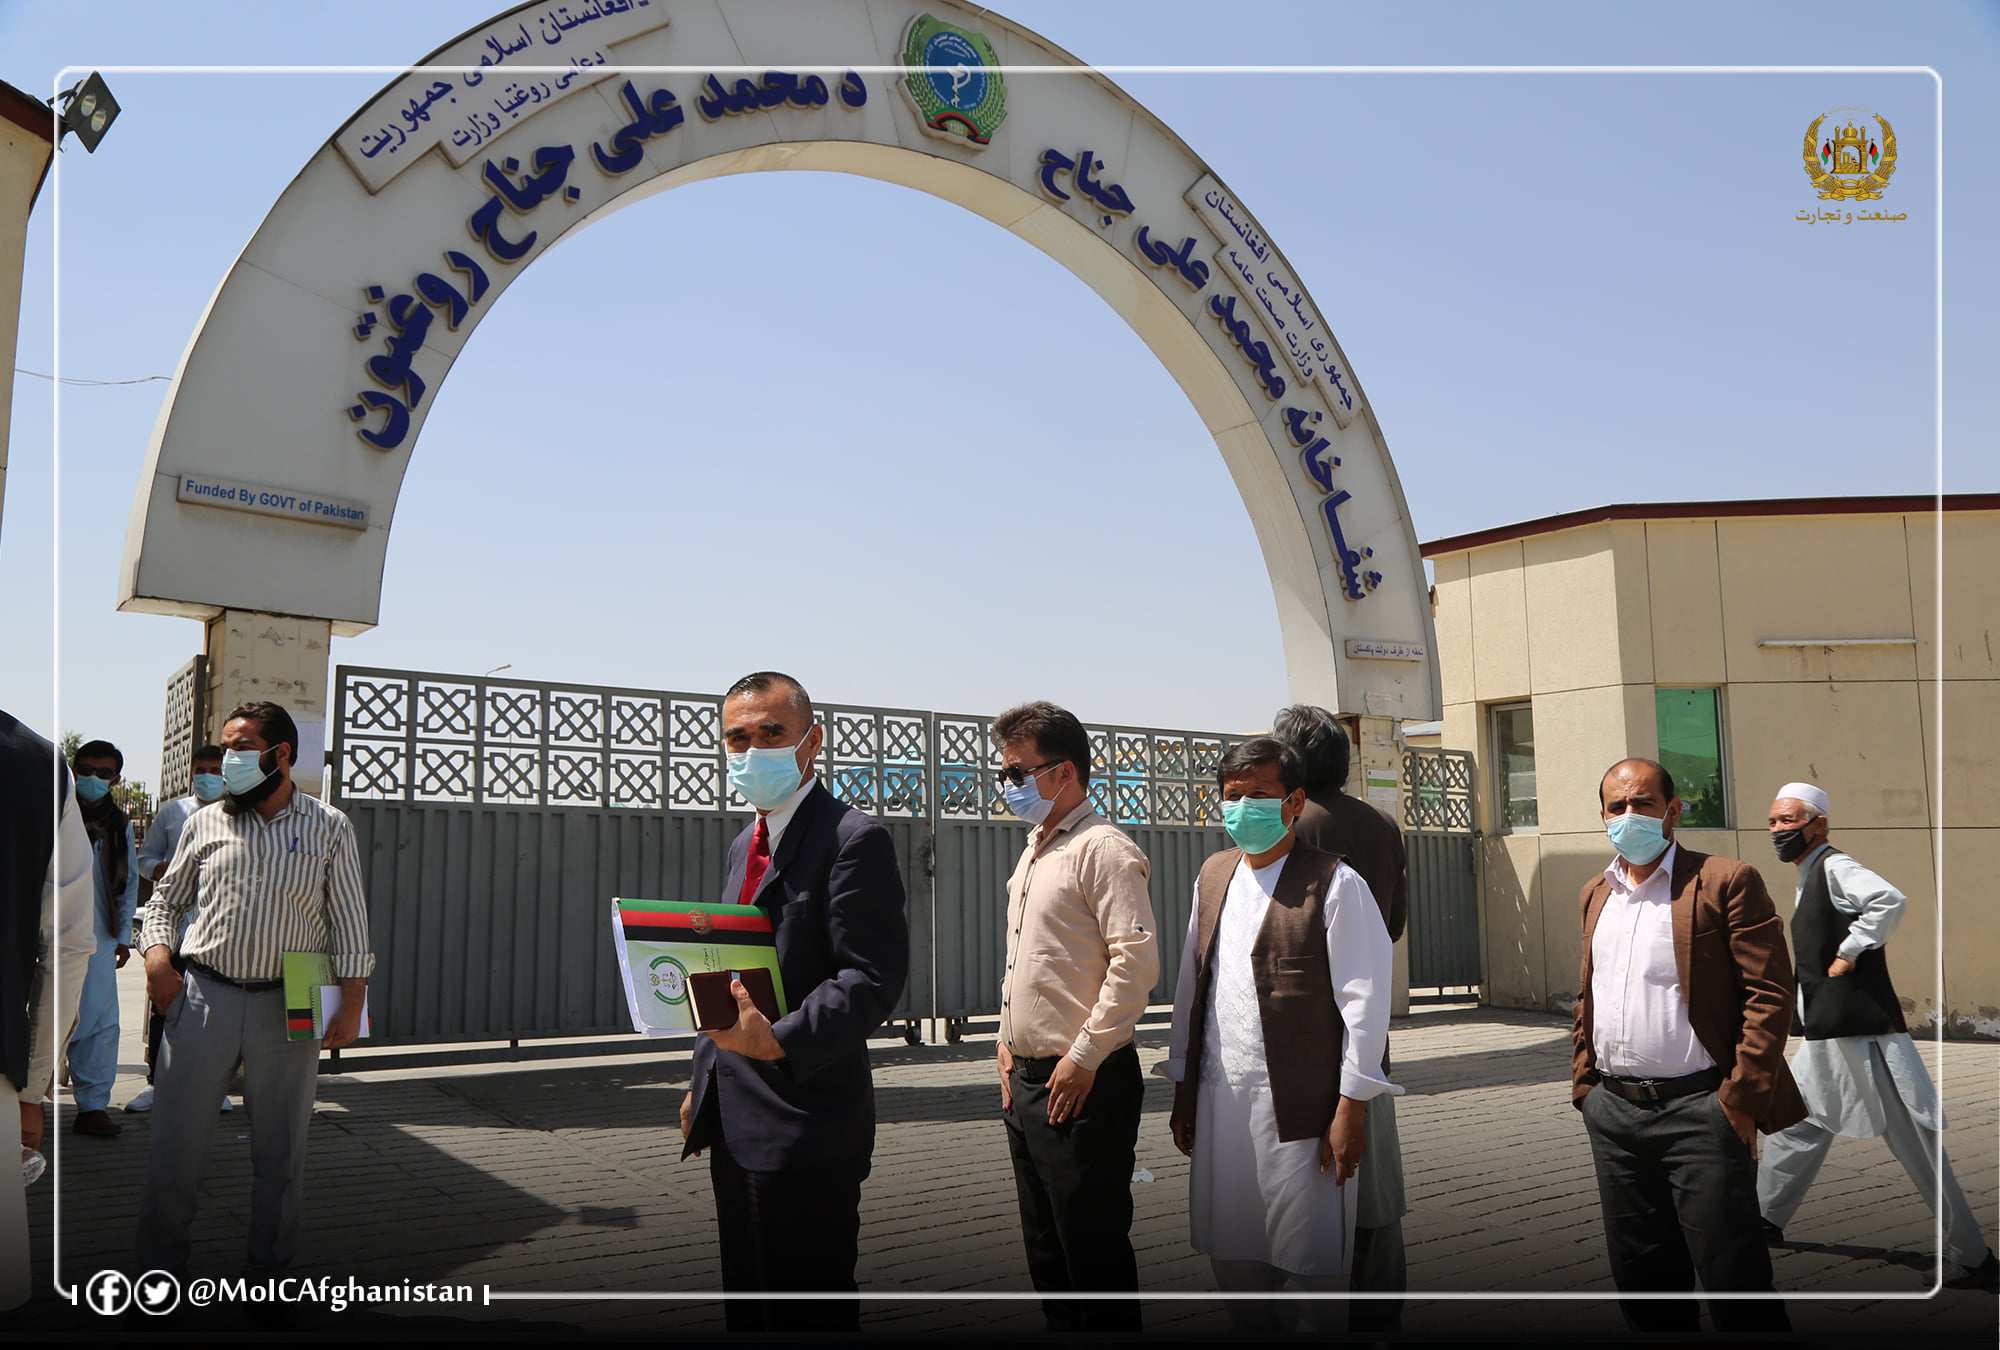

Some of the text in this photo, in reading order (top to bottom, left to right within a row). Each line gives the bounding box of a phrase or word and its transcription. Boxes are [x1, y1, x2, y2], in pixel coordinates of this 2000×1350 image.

[360, 78, 455, 158] جمهوریت
[494, 82, 551, 119] روغتیا
[593, 79, 685, 174] علی
[699, 72, 829, 118] محمد
[841, 67, 868, 107] د
[451, 110, 501, 147] وزارت
[472, 144, 581, 260] جناح
[1040, 148, 1136, 227] جناح
[1137, 225, 1210, 290] علی
[1205, 189, 1352, 411] جمهوری اسلامی افغانستان
[1229, 250, 1313, 378] وزارت صحت عامه
[353, 250, 490, 449] روغتون
[1210, 293, 1286, 399] محمد
[186, 479, 365, 520] Funded By GOVT of Pakistan
